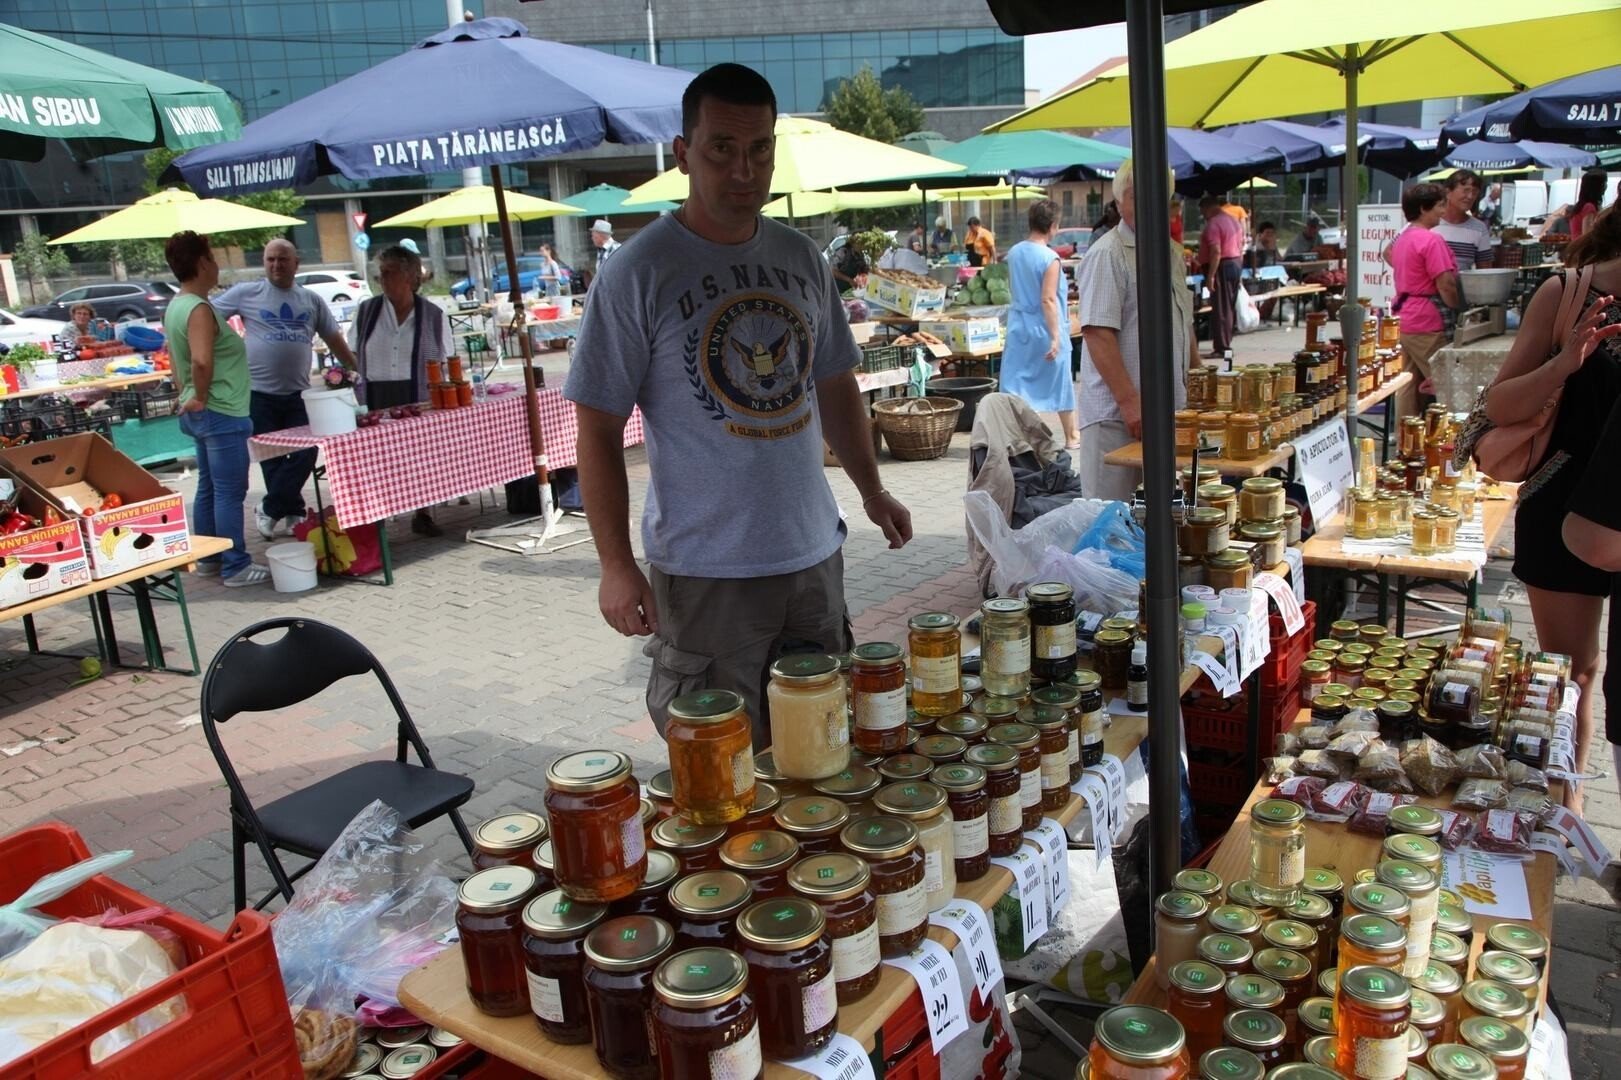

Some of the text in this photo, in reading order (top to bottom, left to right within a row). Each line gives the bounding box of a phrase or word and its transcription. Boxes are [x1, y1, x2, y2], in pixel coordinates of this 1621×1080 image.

[32, 95, 101, 127] SIBIU
[1567, 103, 1608, 121] SALA
[373, 117, 567, 169] PIAȚA ȚĂRĂNEASCĂ
[206, 165, 231, 190] SALA
[1368, 214, 1391, 222] SECTOR:
[1361, 228, 1396, 241] LEGUME
[678, 263, 809, 321] U.S. NAVY
[710, 300, 807, 357] UNITED STATES
[751, 391, 796, 411] NAVY
[97, 498, 181, 525] PREMIUM BANANAS
[31, 523, 76, 543] PREMIUM
[165, 541, 188, 555] Dole
[61, 570, 88, 585] Dole
[1052, 871, 1061, 904] 12
[961, 912, 978, 931] MIERE
[1026, 901, 1034, 934] 11
[919, 952, 941, 971] MIERE
[975, 950, 990, 990] 20
[929, 966, 949, 989] DE TEI
[931, 993, 952, 1036] 22
[825, 1046, 850, 1068] MIERE
